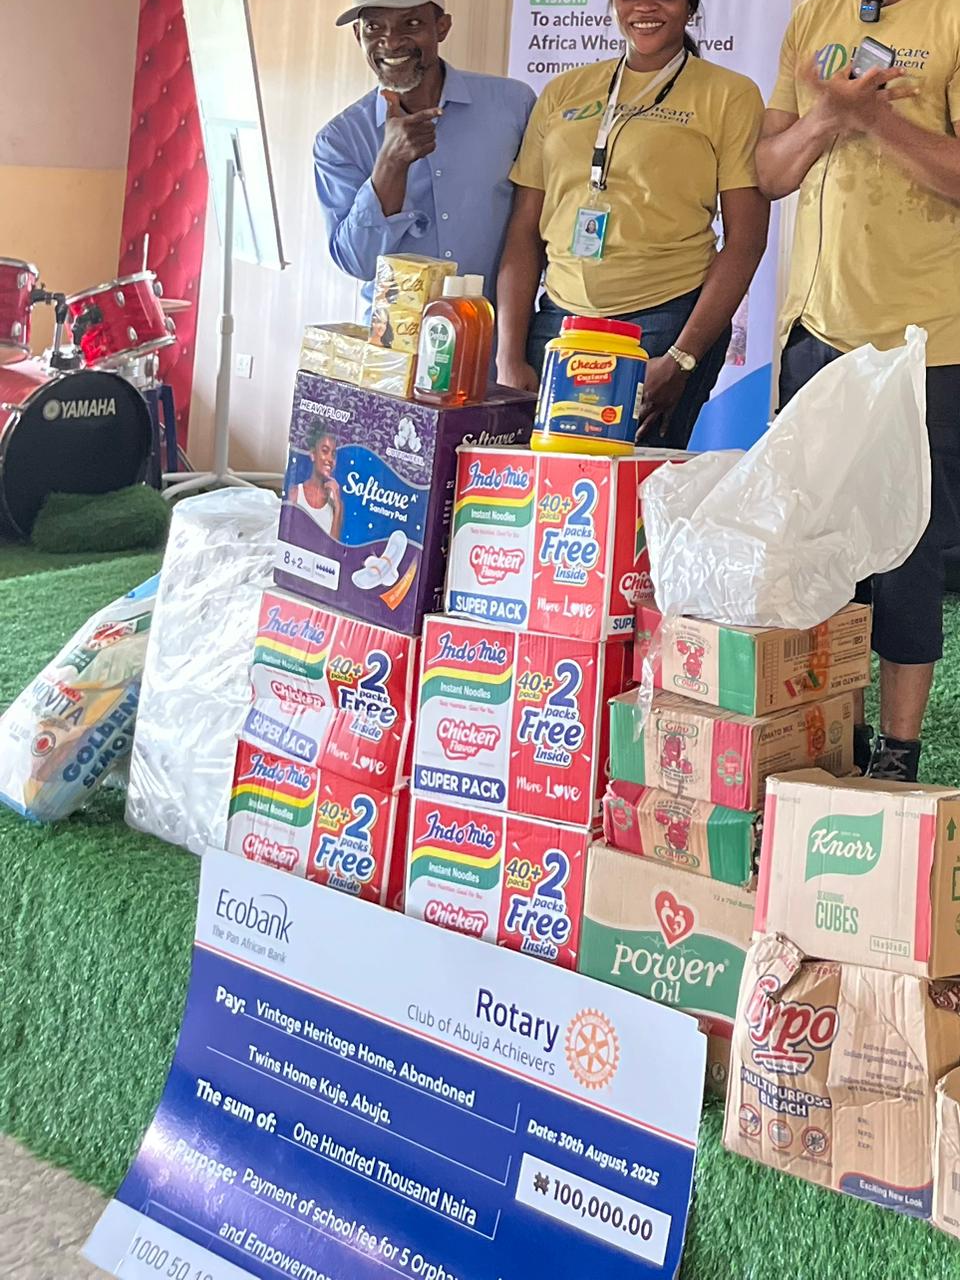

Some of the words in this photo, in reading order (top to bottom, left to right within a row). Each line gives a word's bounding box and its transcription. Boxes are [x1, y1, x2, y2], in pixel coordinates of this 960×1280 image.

[531, 12, 549, 26] To
[552, 11, 612, 27] achieve
[528, 35, 577, 50] Africa
[570, 359, 613, 372] Checkers
[62, 398, 116, 418] YAMAHA
[300, 399, 326, 417] HEAVY
[325, 406, 351, 422] FLOW
[342, 471, 410, 510] Softcare
[369, 503, 394, 519] Sanitary
[394, 510, 408, 523] Pad
[471, 508, 491, 520] Instant
[492, 510, 516, 522] Noodles
[564, 526, 592, 538] packs
[471, 545, 521, 569] Chicken
[541, 531, 597, 564] Free
[481, 567, 505, 579] Flavor
[555, 566, 586, 581] Inside
[456, 595, 490, 617] SUPER
[492, 600, 522, 620] PACK
[537, 597, 560, 613] More
[359, 690, 389, 704] packs
[440, 682, 463, 696] Instant
[464, 685, 491, 699] Noodles
[339, 687, 395, 724] Free
[545, 708, 576, 721] packs
[62, 692, 139, 784] GOLDEN
[438, 719, 496, 747] Chicken
[519, 710, 582, 747] Free
[664, 721, 689, 734] Gino
[327, 742, 350, 761] More
[451, 743, 478, 754] Flavor
[535, 747, 570, 763] Inside
[420, 772, 458, 792] SUPER
[461, 779, 500, 800] PACK
[516, 776, 543, 793] More
[244, 835, 297, 866] Chicken
[316, 836, 373, 877] Free
[341, 838, 369, 853] packs
[811, 828, 877, 861] Knorr
[328, 873, 360, 893] Inside
[429, 862, 451, 877] Instant
[452, 867, 480, 883] Noodles
[216, 888, 293, 944] Ecobank
[426, 901, 483, 932] Chicken
[533, 897, 564, 913] packs
[507, 898, 569, 940] Free
[815, 901, 859, 935] CUBES
[212, 924, 225, 936] The
[226, 931, 240, 945] Pan
[241, 937, 266, 957] African
[267, 945, 287, 964] Bank
[522, 937, 557, 958] Inside
[650, 980, 681, 1003] Oil
[476, 987, 560, 1053] Rotary
[215, 985, 246, 1014] Pay:
[256, 999, 301, 1034] Vintage
[304, 1020, 357, 1058] Heritage
[358, 1043, 397, 1076] Home,
[399, 1062, 476, 1107] Abandoned
[407, 1004, 435, 1028] Club
[438, 1017, 452, 1034] of
[453, 1022, 490, 1051] Abuja
[493, 1038, 556, 1077] Achievers
[248, 1045, 281, 1074] Twins
[282, 1061, 317, 1090] Home
[319, 1077, 349, 1107] Kuje,
[351, 1093, 391, 1124] Abuja.
[741, 1067, 831, 1108] MULTIPURPOSE
[760, 1092, 807, 1117] BLEACH
[196, 1078, 222, 1106] The
[222, 1096, 255, 1123] sum
[256, 1111, 277, 1134] of:
[293, 1122, 319, 1149] One
[320, 1134, 376, 1176] Hundred
[377, 1160, 439, 1208] Thousand
[441, 1191, 477, 1226] Naira
[527, 1119, 557, 1145] Date:
[558, 1132, 584, 1156] 30th
[585, 1145, 629, 1177] August,
[630, 1163, 660, 1187] 2025
[859, 1179, 888, 1199] Exciting
[888, 1188, 904, 1202] New
[905, 1192, 923, 1208] Look
[242, 1168, 298, 1210] Payment
[298, 1199, 315, 1217] of
[312, 1206, 357, 1239] school
[355, 1224, 377, 1250] fee
[379, 1236, 399, 1261] for
[399, 1247, 411, 1267] 5
[411, 1254, 458, 1280] Orpha
[130, 1236, 170, 1270] 1000
[219, 1222, 248, 1246] and
[244, 1232, 333, 1280] Empowerme
